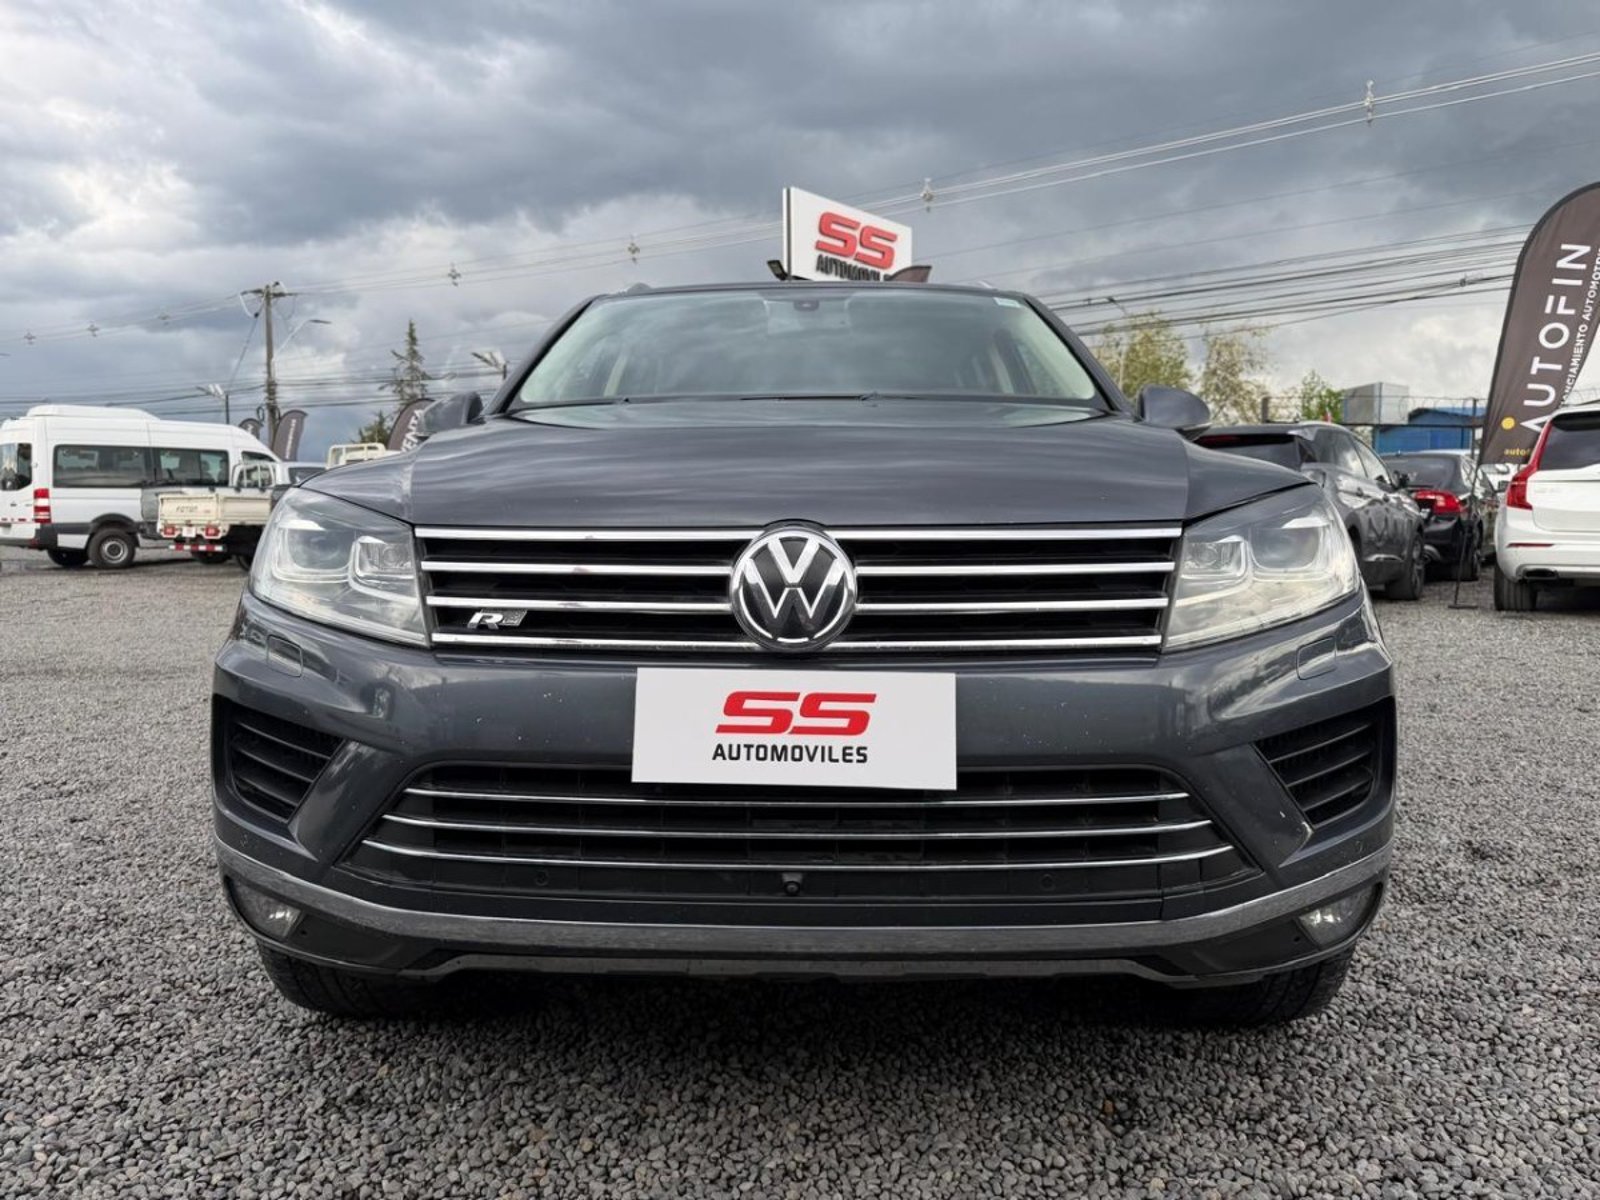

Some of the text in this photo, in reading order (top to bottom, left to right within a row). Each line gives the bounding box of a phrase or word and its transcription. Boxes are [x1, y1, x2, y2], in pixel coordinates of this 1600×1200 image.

[815, 212, 897, 269] SS
[1519, 244, 1591, 432] AUTOFIN
[716, 691, 877, 736] SS
[712, 743, 868, 763] AUTOMOVILES
